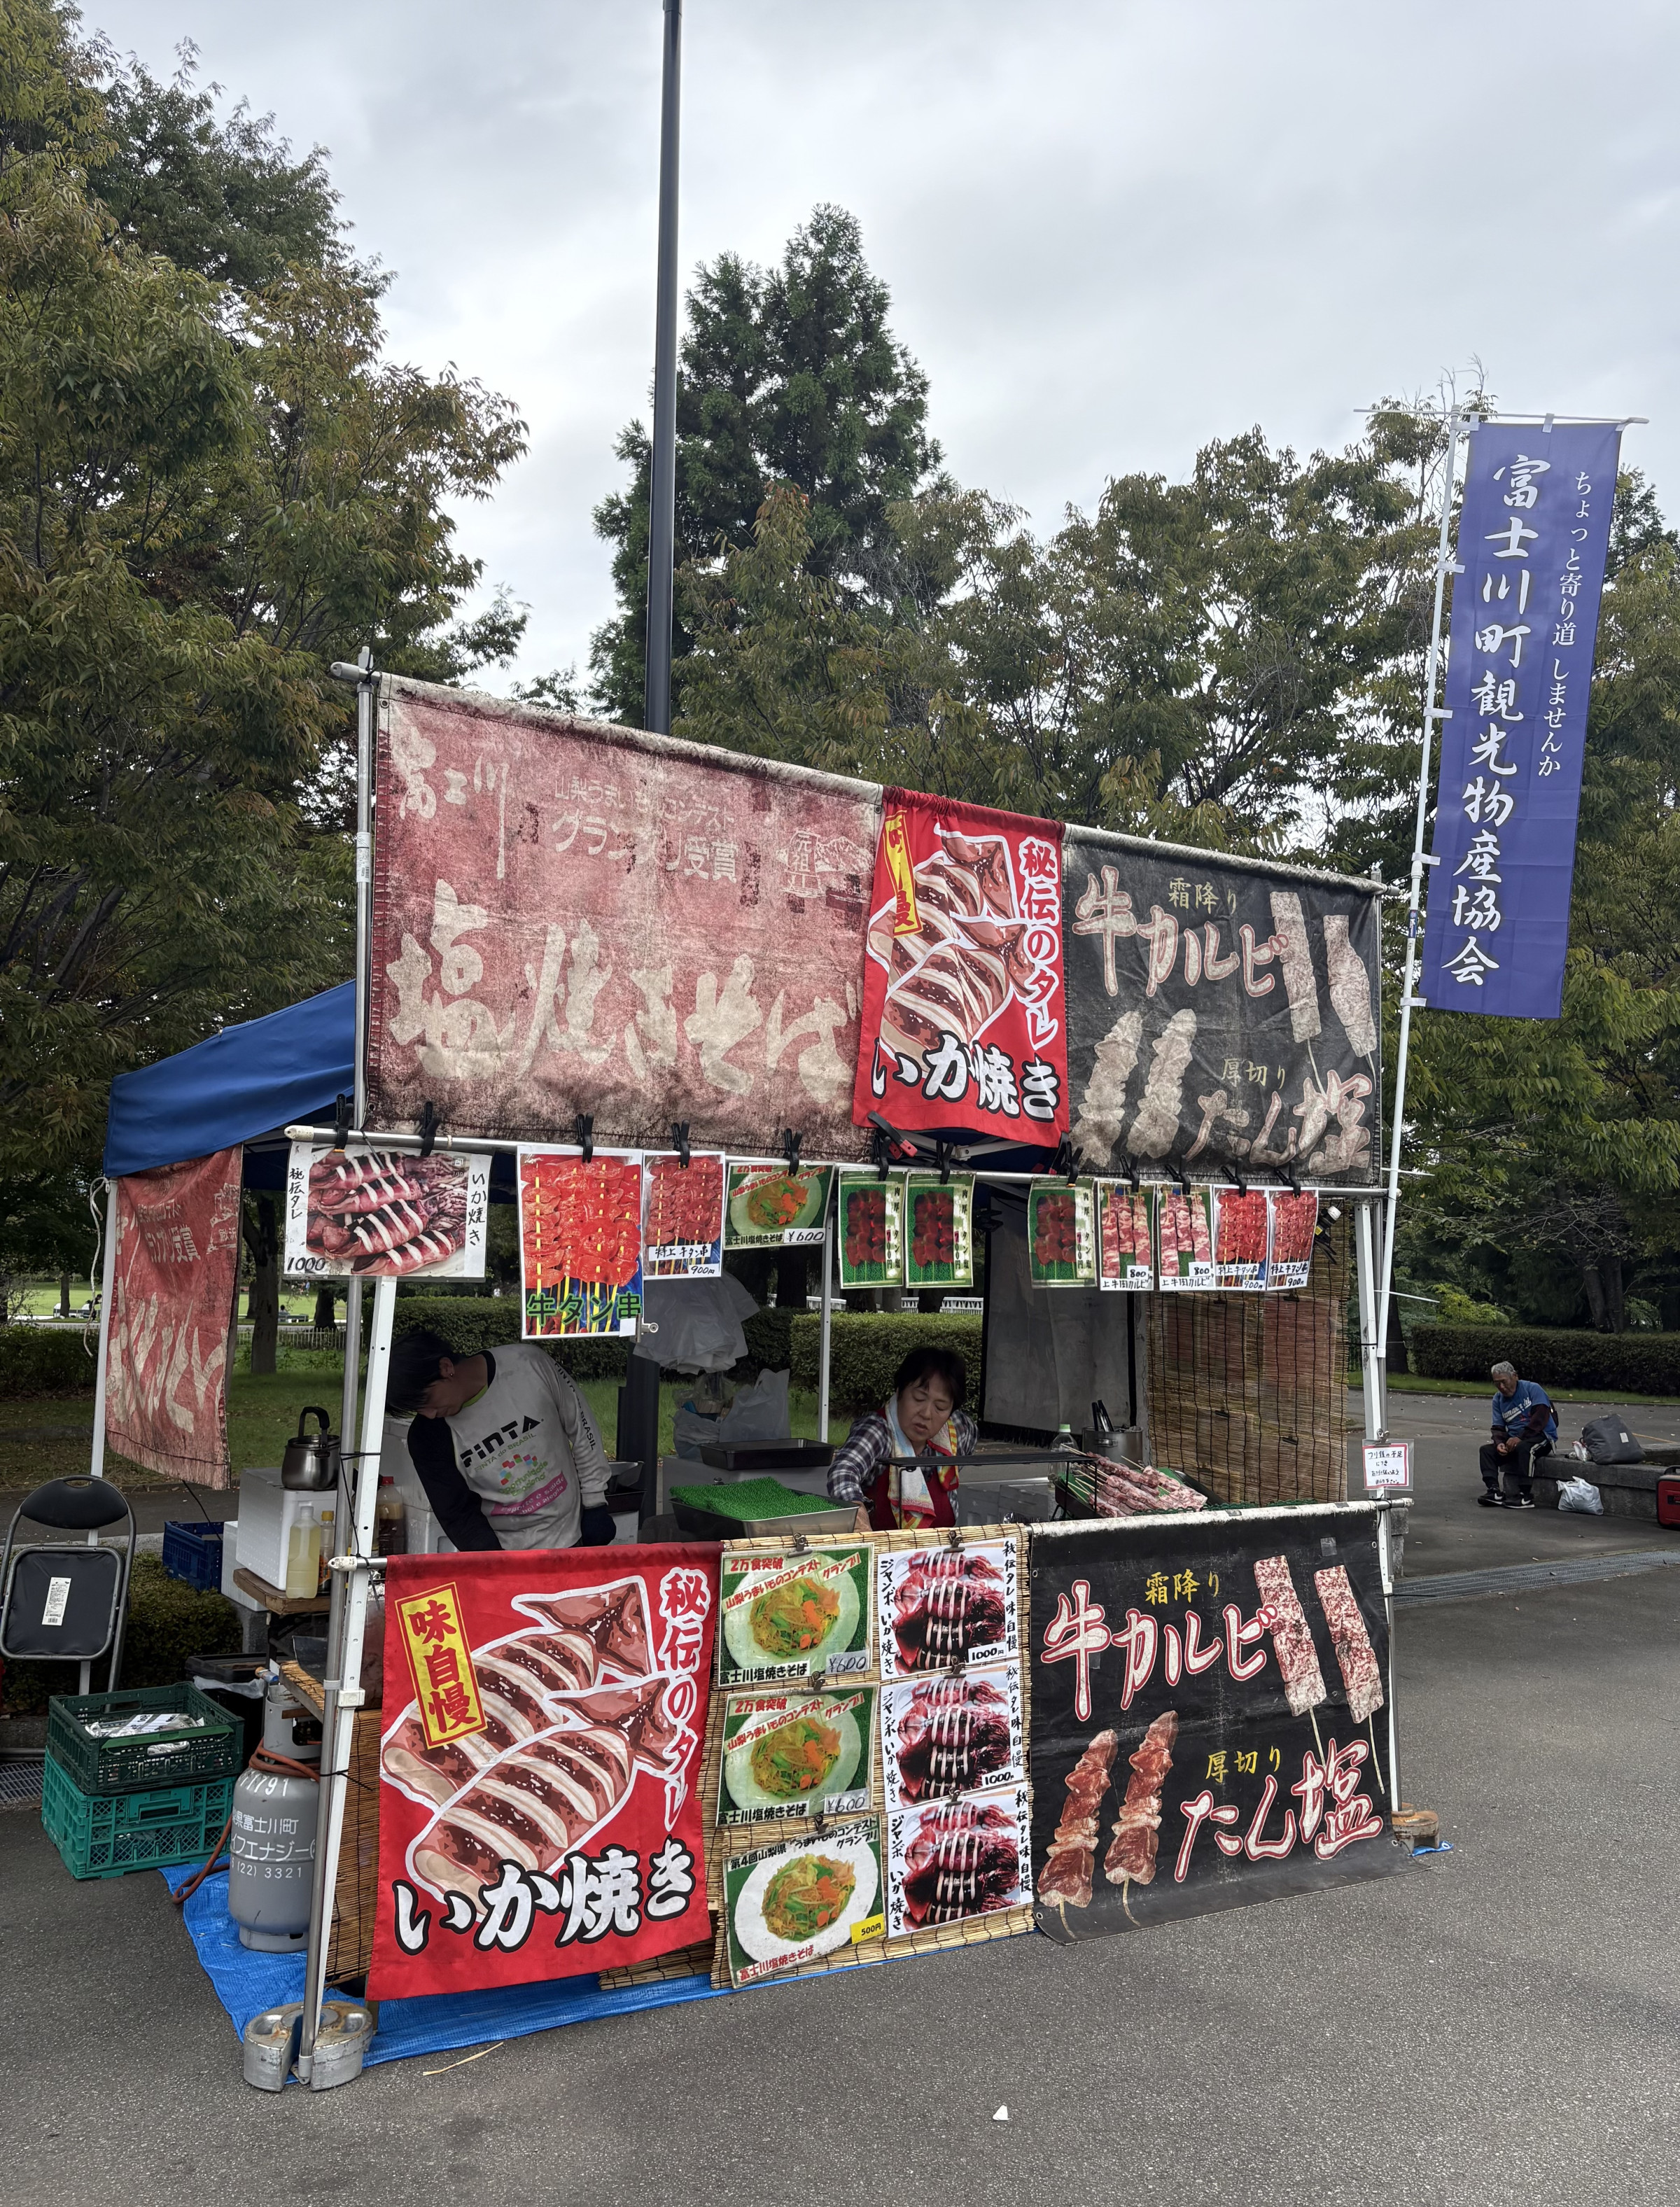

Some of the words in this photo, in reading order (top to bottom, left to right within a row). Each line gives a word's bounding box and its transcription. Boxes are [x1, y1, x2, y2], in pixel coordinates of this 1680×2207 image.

[1551, 471, 1592, 647] ちょっと寄り道
[1441, 454, 1551, 987] 富士川町観光物産協会
[1537, 657, 1571, 778] しませんか
[1168, 878, 1238, 914] 霜降り
[1021, 837, 1059, 1050] 秘伝のタレ
[1072, 865, 1289, 997] 牛カルビ
[872, 1030, 1060, 1120] いか焼き
[1222, 1056, 1286, 1089] 厚切り
[1185, 1070, 1373, 1176] たん塩
[288, 1168, 305, 1220] 秘伝タレ
[468, 1172, 487, 1246] いか焼き
[724, 1233, 783, 1245] 富士川塩焼きそば
[788, 1231, 825, 1242] ¥600
[286, 1256, 326, 1271] 1000
[690, 1265, 715, 1275] 900円
[1130, 1269, 1146, 1277] 800
[526, 1291, 643, 1326] 牛タン串
[507, 1433, 537, 1450] BRASIL
[730, 1557, 783, 1572] 2万食突破
[822, 1554, 860, 1579] グランプリ
[879, 1559, 896, 1606] ジャンボ
[725, 1559, 821, 1609] 山梨うまいものコンテスト
[1145, 1568, 1220, 1605] 霜降り
[881, 1613, 897, 1674] いか焼き
[972, 1646, 1005, 1661] 1000円
[1042, 1579, 1278, 1722] 牛カルビ
[407, 1599, 479, 1732] 味自慢
[720, 1667, 808, 1685] 富士川塩焼きそば
[829, 1657, 867, 1672] ¥600
[660, 1568, 709, 1830] 秘伝のタレ
[734, 1697, 788, 1713] 2万食突破
[825, 1693, 864, 1718] グランプリ
[882, 1691, 897, 1737] ジャンボ
[1005, 1665, 1024, 1768] 秘伝タレ味自慢
[727, 1699, 824, 1751] 山梨うまいものコンテスト
[884, 1743, 900, 1802] いか焼き
[1205, 1745, 1282, 1784] 厚切り
[718, 1803, 806, 1824] 富士川塩焼きそば
[827, 1797, 865, 1813] ¥600
[1174, 1738, 1383, 1883] たん塩
[836, 1830, 877, 1849] グランプリ
[890, 1815, 905, 1859] ジャンボ
[264, 1866, 302, 1879] 3321
[729, 1844, 787, 1870] 第4回山梨県
[392, 1835, 696, 1954] いか焼き
[889, 1871, 905, 1931] いか焼き
[861, 1922, 882, 1937] 500円
[738, 1945, 814, 1982] 富士川塩焼きそば
